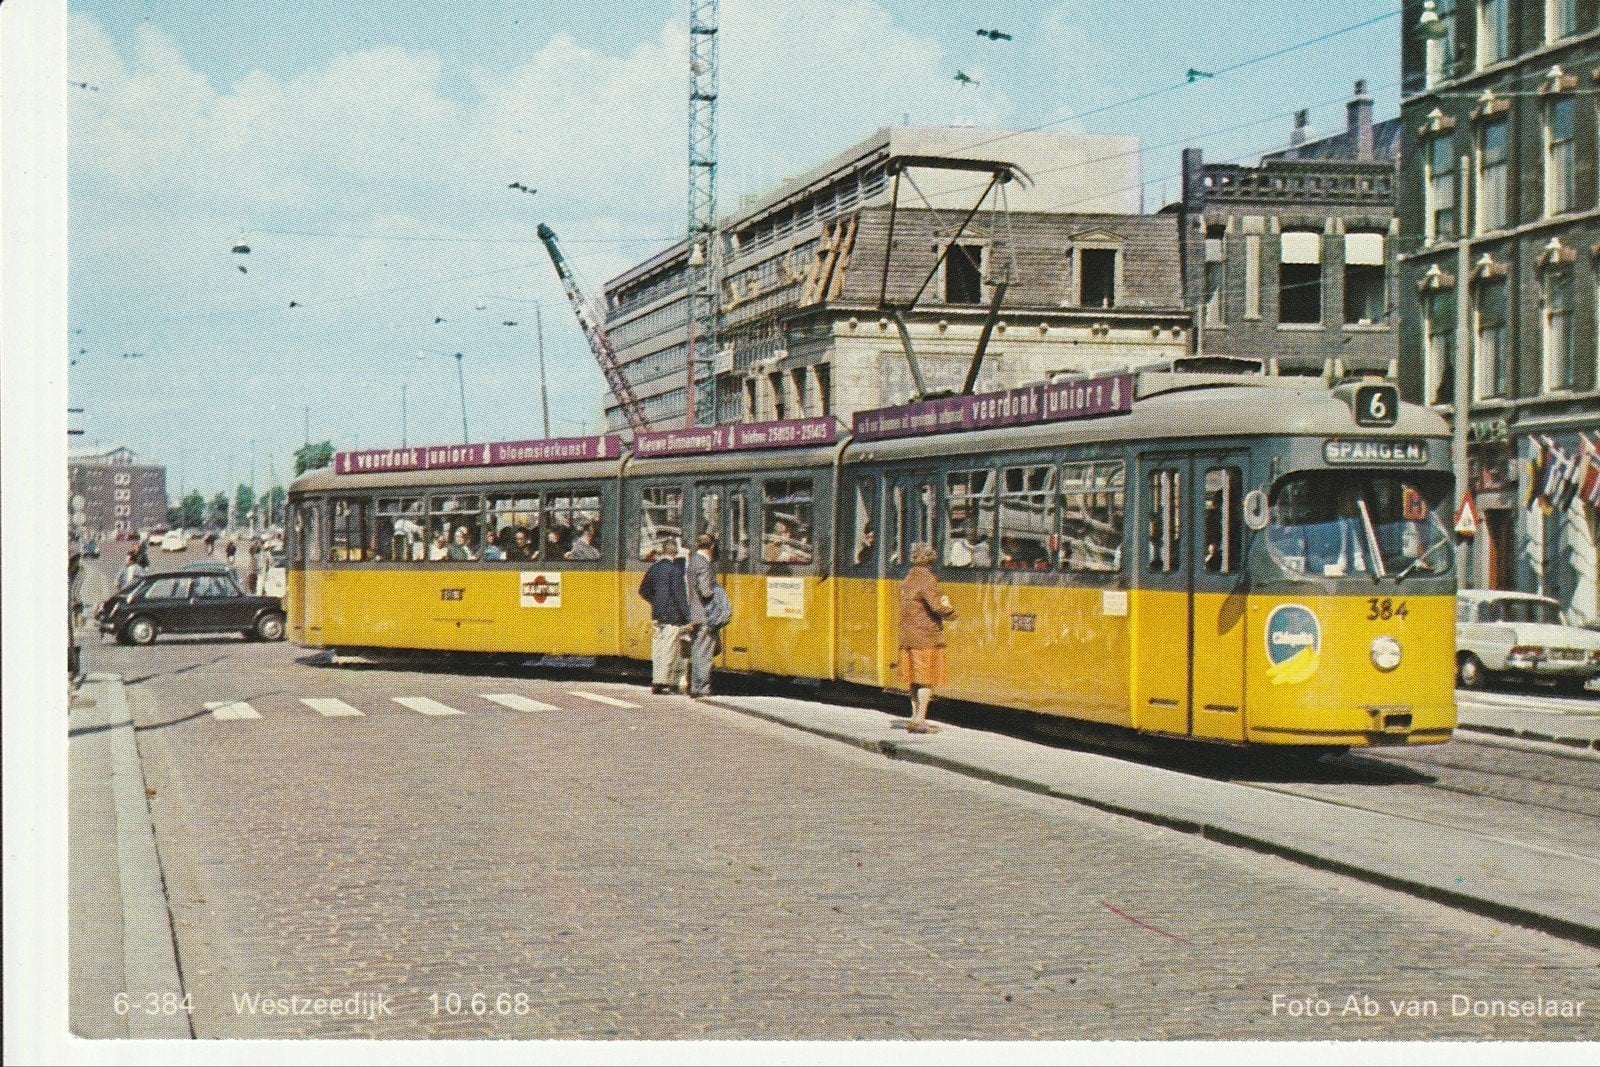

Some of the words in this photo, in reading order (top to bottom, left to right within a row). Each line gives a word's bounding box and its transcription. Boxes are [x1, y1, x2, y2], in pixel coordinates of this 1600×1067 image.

[1370, 392, 1386, 418] 6
[500, 443, 587, 460] bloemsierkunst
[1326, 442, 1420, 459] SPANGEN
[1366, 597, 1409, 621] 384
